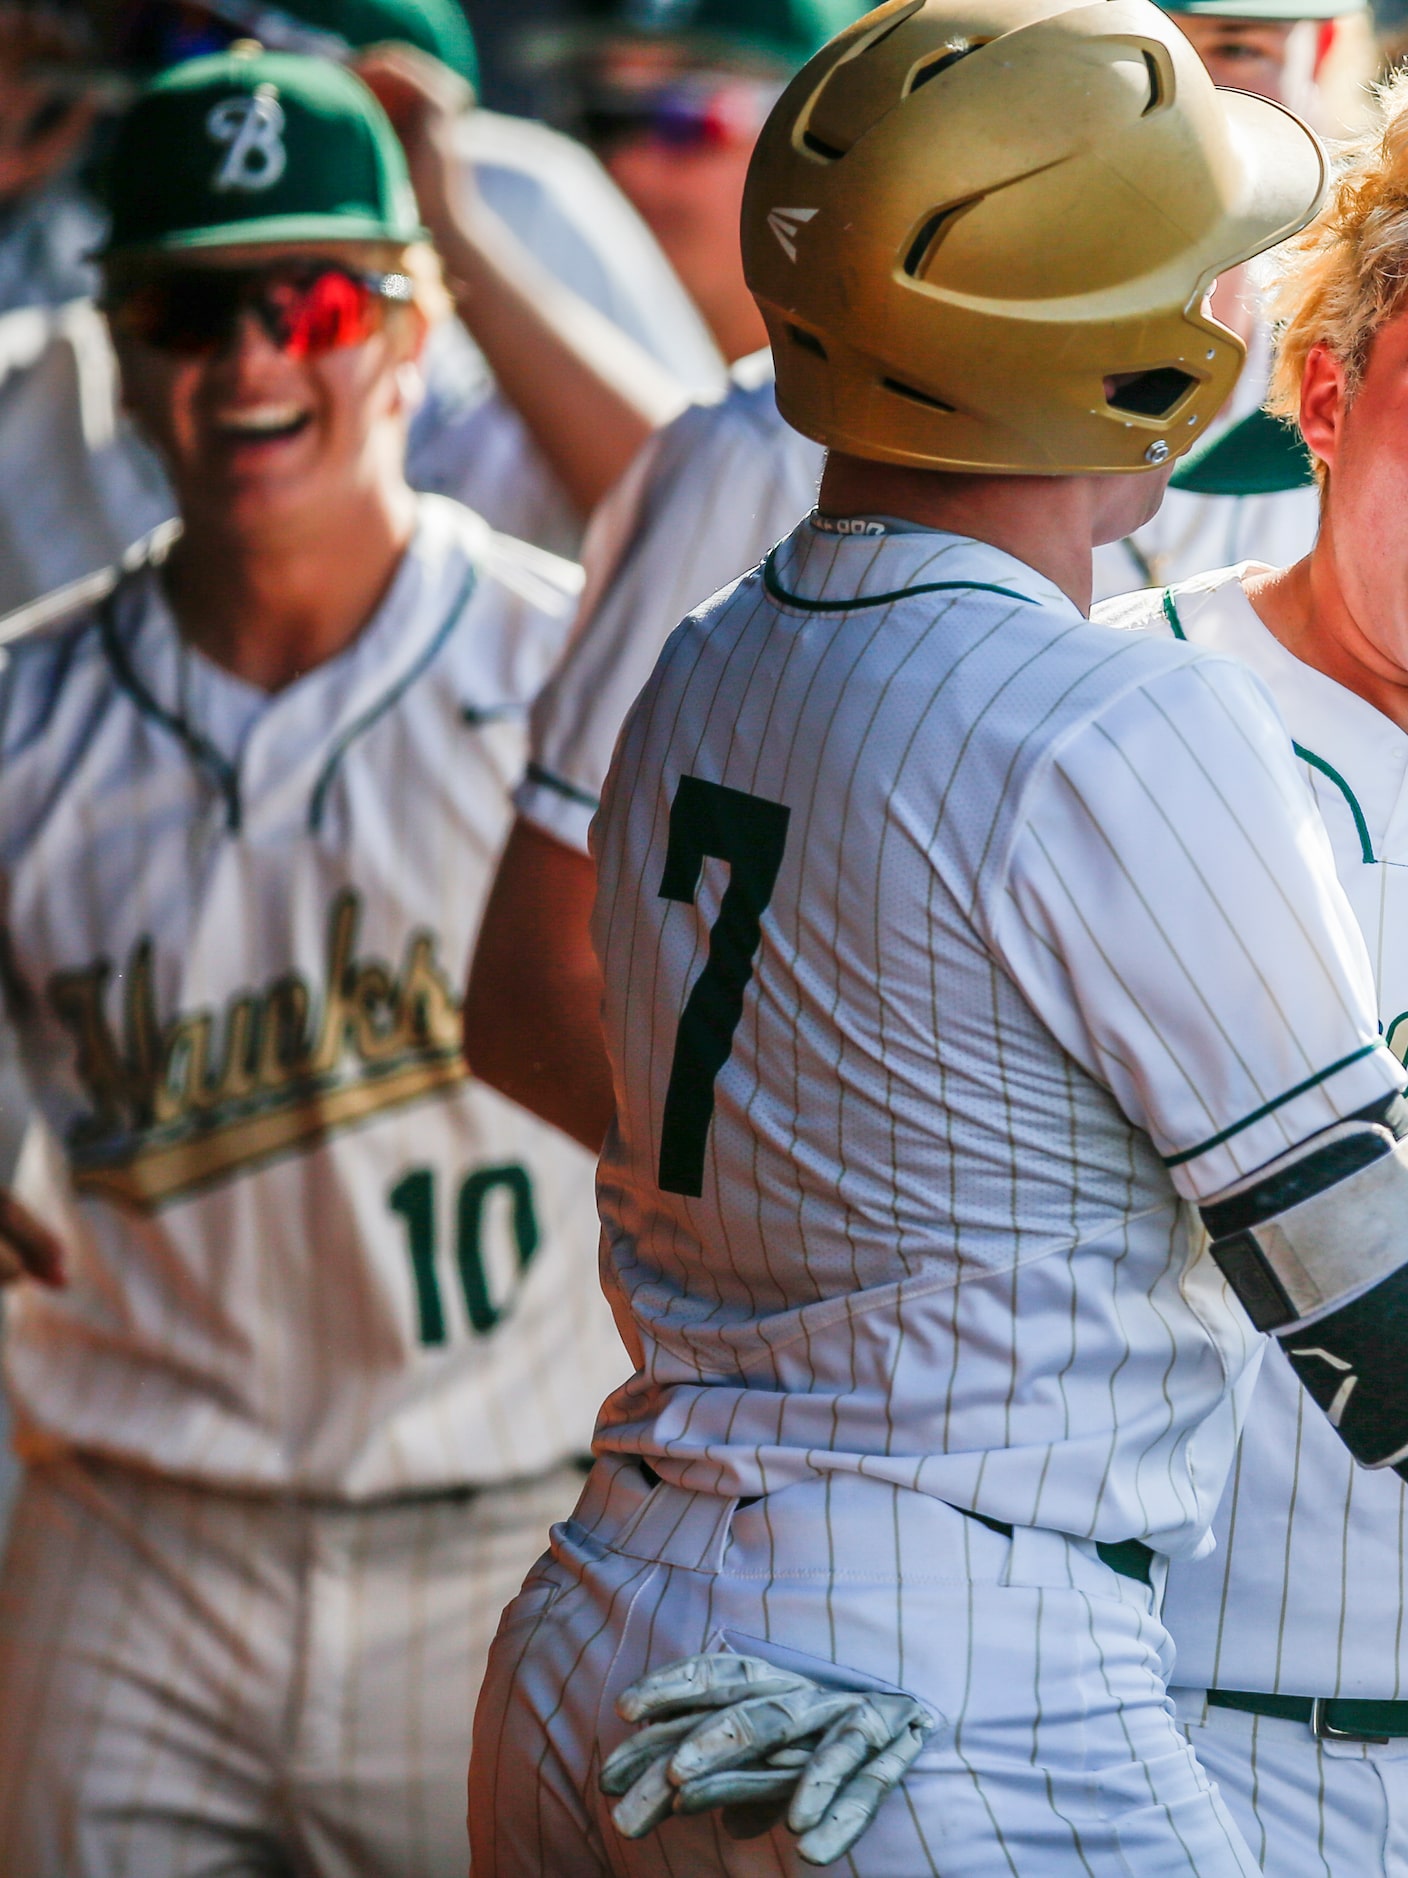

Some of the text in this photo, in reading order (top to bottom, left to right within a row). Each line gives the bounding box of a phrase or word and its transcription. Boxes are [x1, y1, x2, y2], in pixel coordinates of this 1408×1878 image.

[206, 92, 287, 191] B
[46, 890, 463, 1135] Hawks
[657, 774, 791, 1199] 7
[388, 1162, 541, 1346] 10
